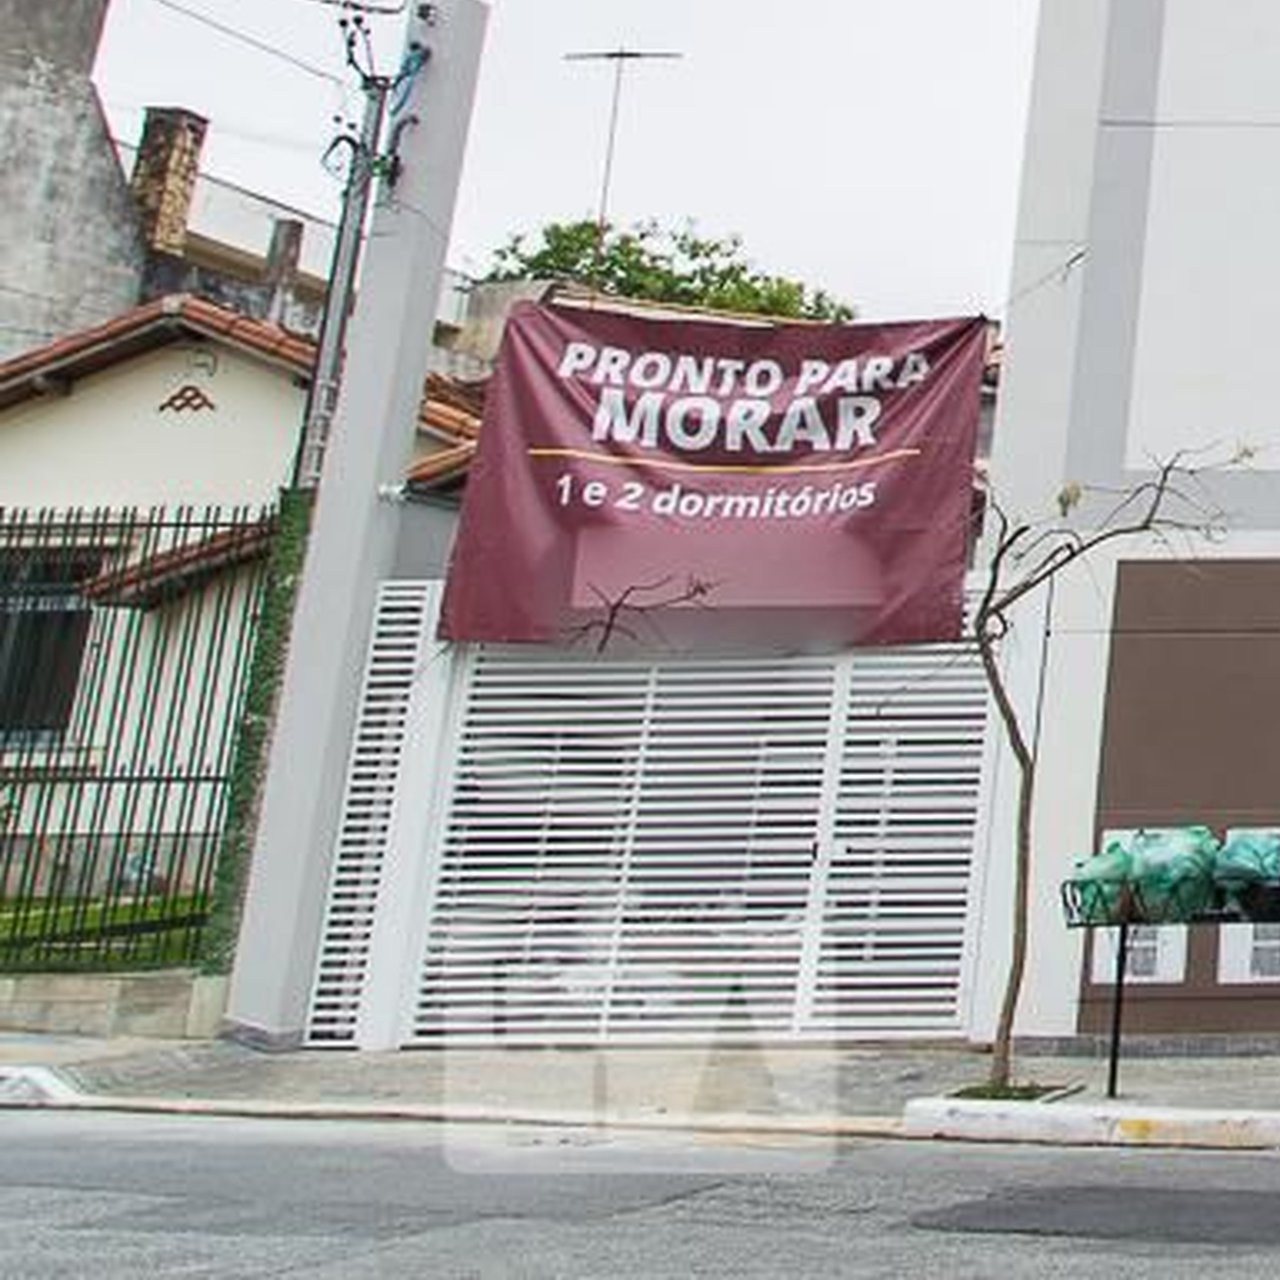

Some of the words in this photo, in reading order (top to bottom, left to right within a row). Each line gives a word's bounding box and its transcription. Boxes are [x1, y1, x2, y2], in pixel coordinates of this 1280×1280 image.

[559, 342, 784, 397] PRONTO
[794, 353, 931, 395] PARA
[592, 388, 881, 452] MORAR
[557, 474, 571, 506] 1
[582, 480, 607, 506] e
[613, 481, 645, 510] 2
[652, 481, 876, 518] dormitórios
